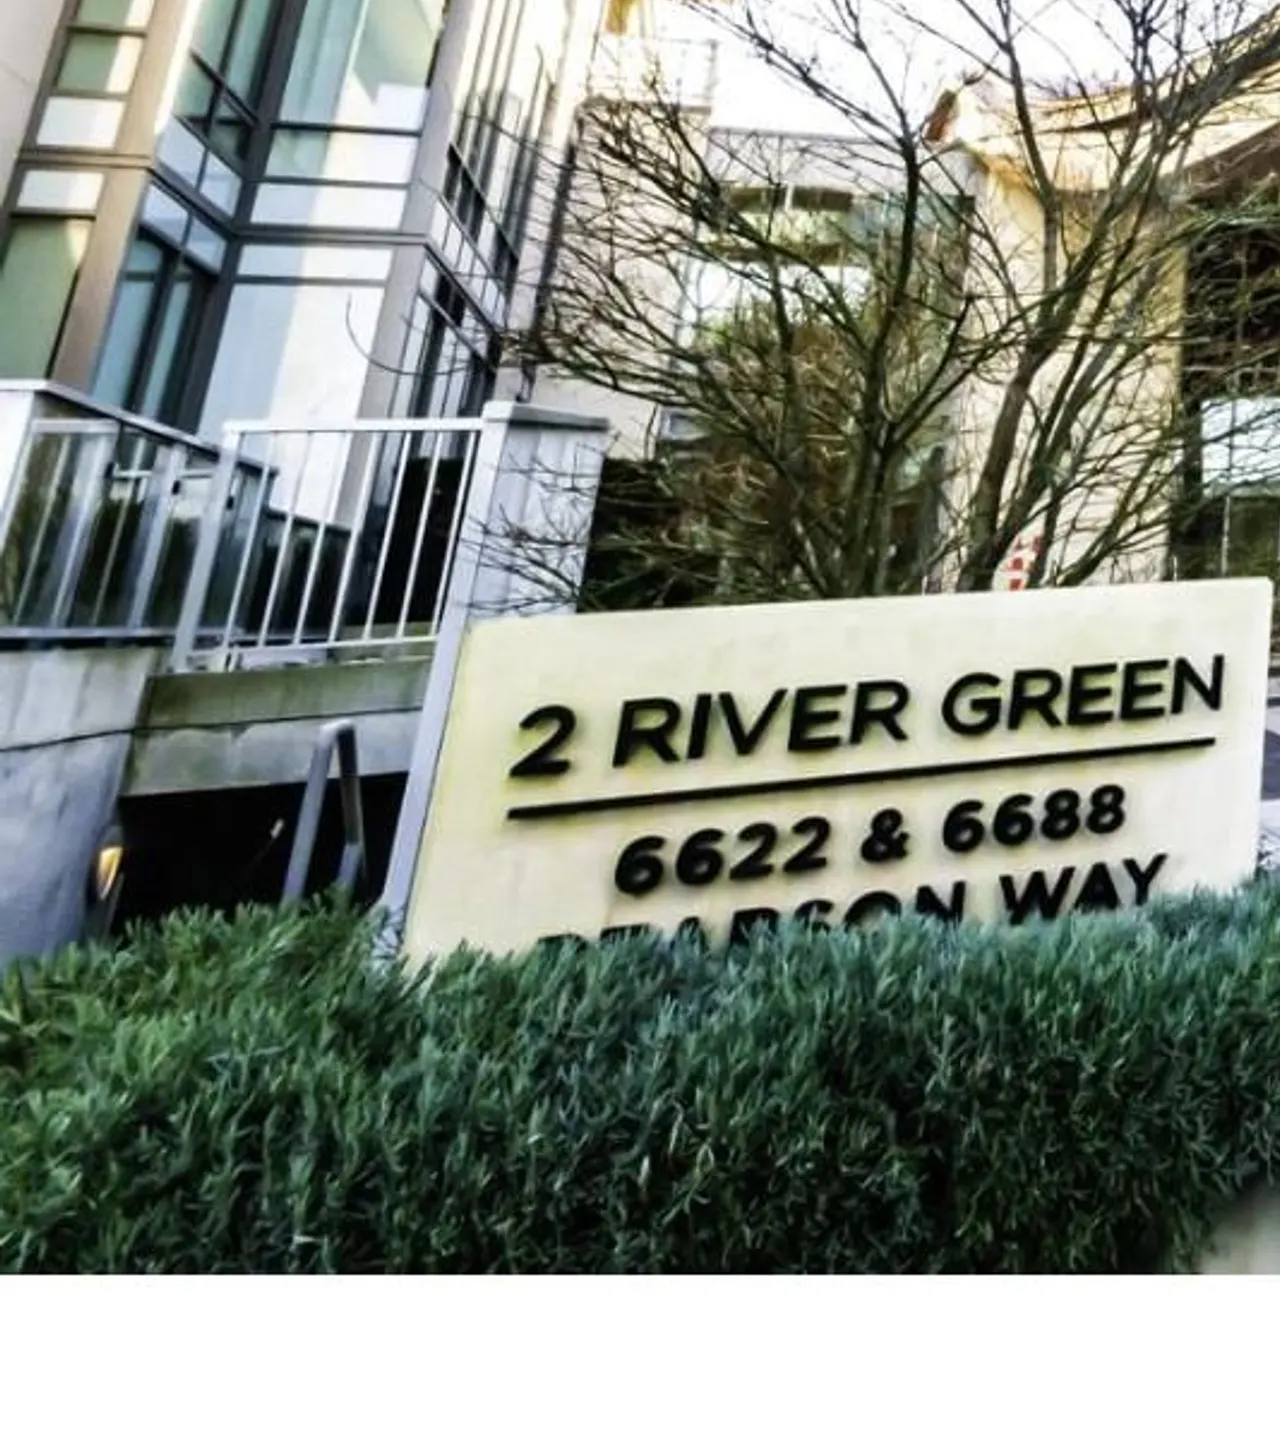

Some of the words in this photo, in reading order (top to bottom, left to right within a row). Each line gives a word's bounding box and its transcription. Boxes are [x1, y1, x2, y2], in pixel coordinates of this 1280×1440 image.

[508, 703, 578, 779] 2
[612, 679, 910, 768] RIVER
[941, 654, 1226, 737] GREEN
[613, 817, 832, 897] 6622
[860, 808, 909, 864] &
[941, 783, 1127, 855] 6688
[999, 852, 1169, 927] WAY
